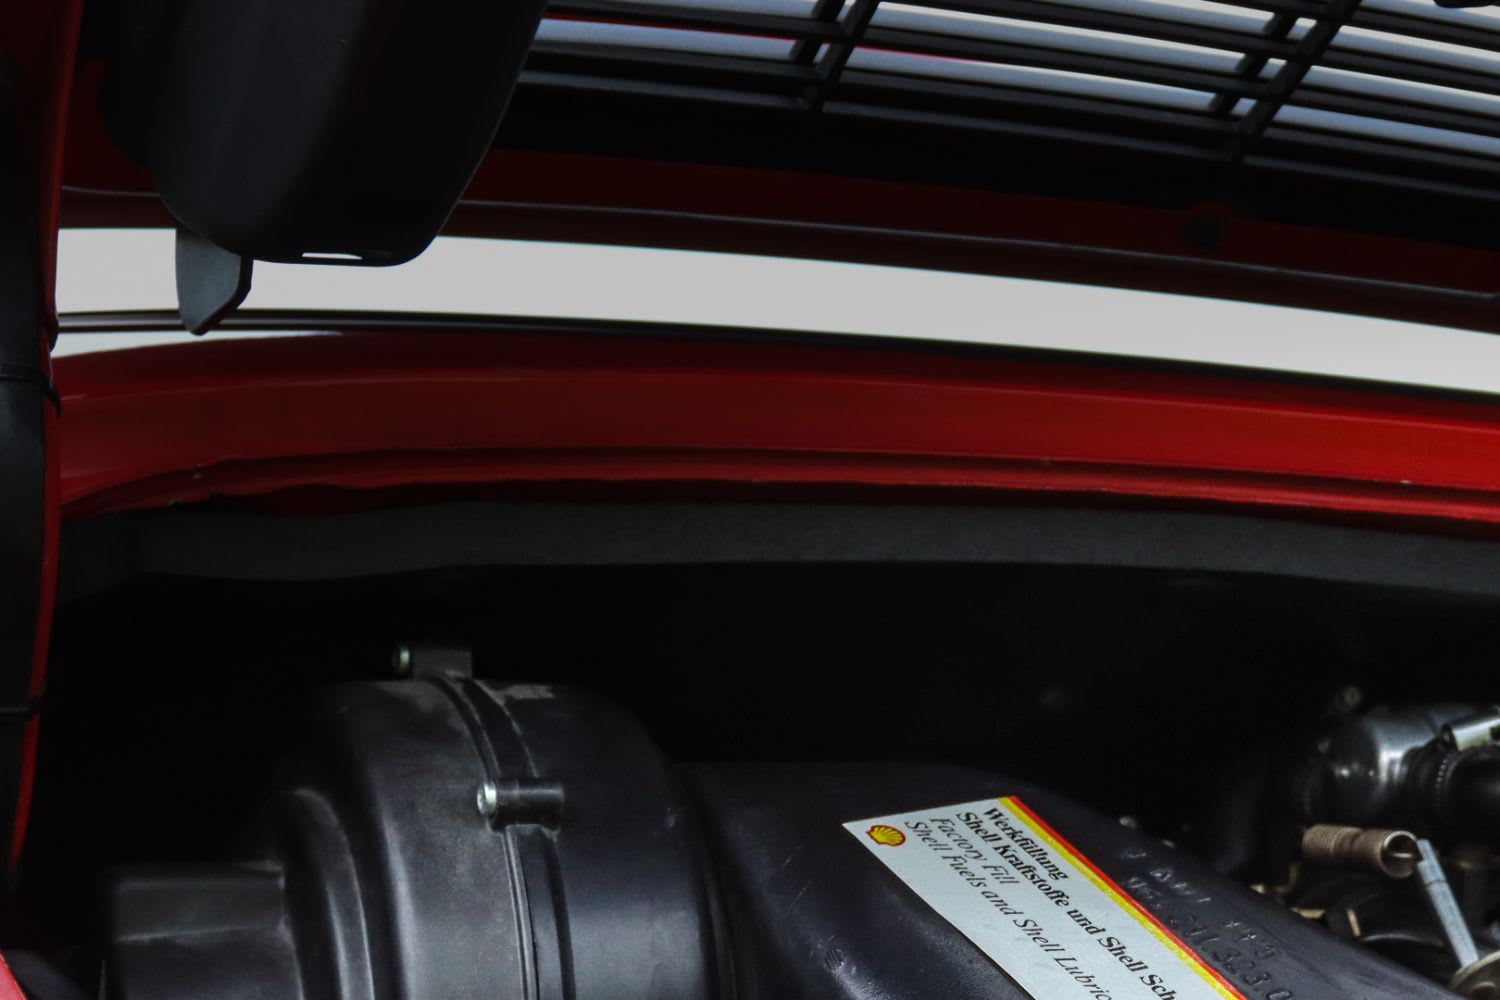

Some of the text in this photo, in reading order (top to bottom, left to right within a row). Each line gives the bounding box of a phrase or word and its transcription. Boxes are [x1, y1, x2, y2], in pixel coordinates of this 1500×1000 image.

[903, 821, 954, 852] Shell
[940, 854, 988, 888] Fuels
[980, 890, 1025, 916] and
[1012, 918, 1067, 953] Shell
[929, 817, 1021, 886] Factory Fill
[955, 811, 1004, 844] Shell
[991, 843, 1070, 908] Kraftstoffe
[1066, 908, 1107, 936] und
[1096, 935, 1150, 973] Shell
[982, 806, 1070, 882] Werkfüllung
